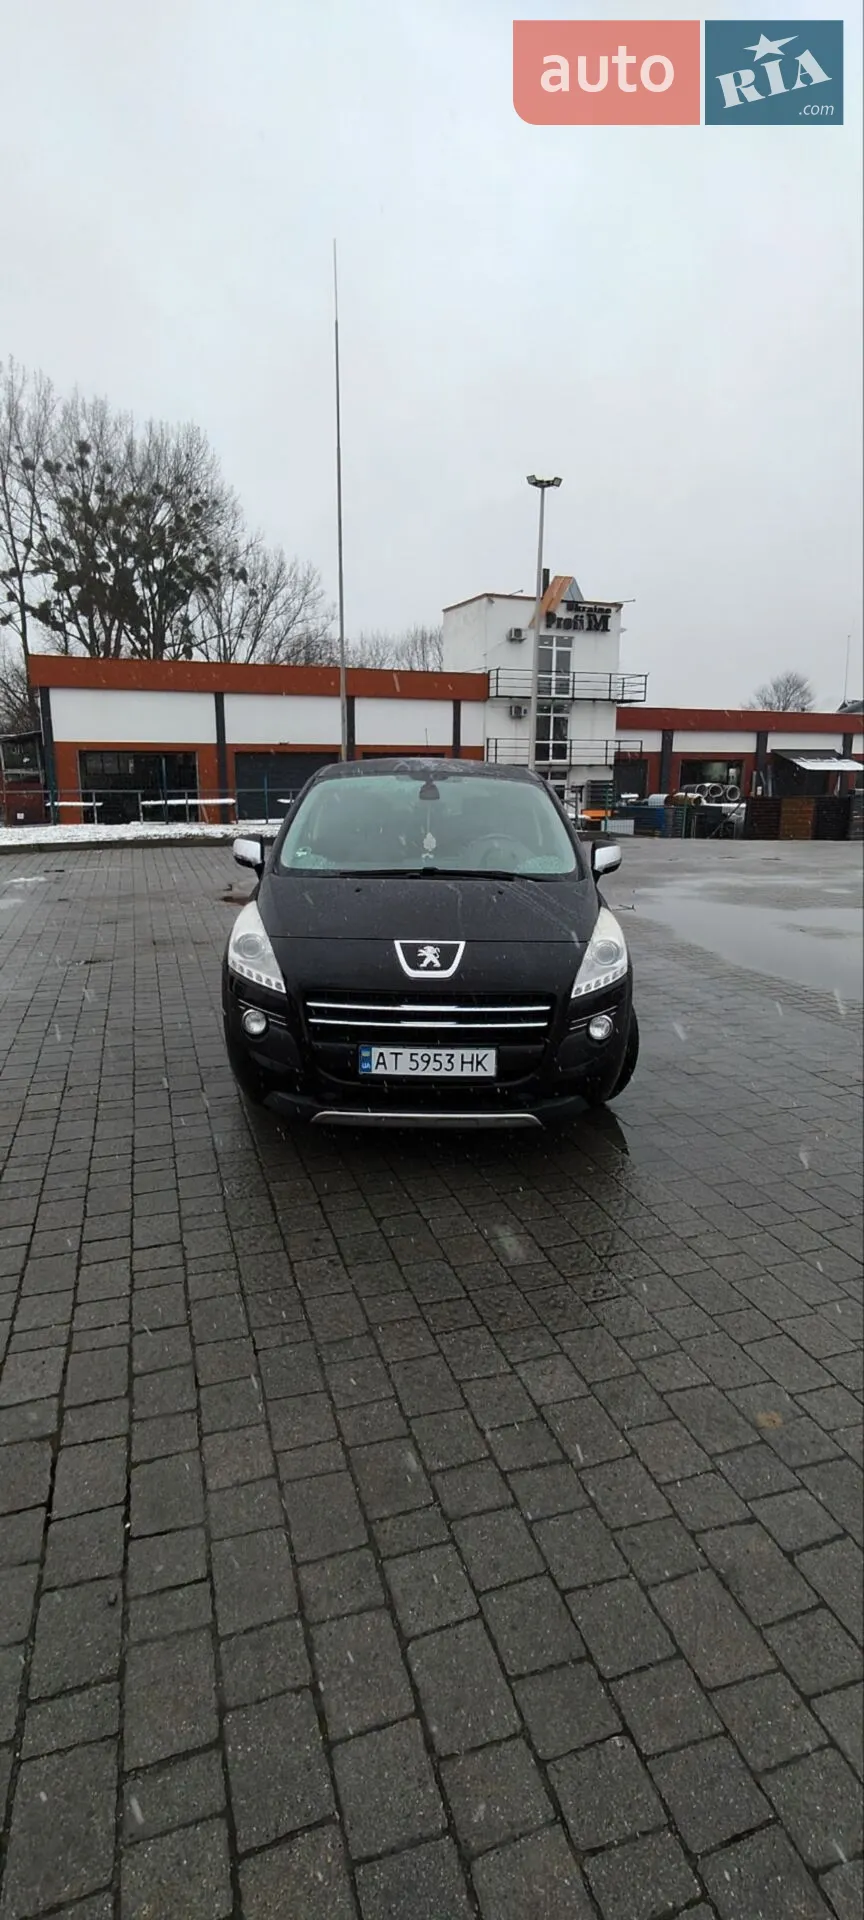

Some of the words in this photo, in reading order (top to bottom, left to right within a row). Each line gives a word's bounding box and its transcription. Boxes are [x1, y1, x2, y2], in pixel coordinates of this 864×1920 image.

[566, 602, 611, 613] Ukraine
[375, 1052, 403, 1070] AT
[409, 1053, 455, 1072] 5953
[460, 1053, 489, 1072] HK
